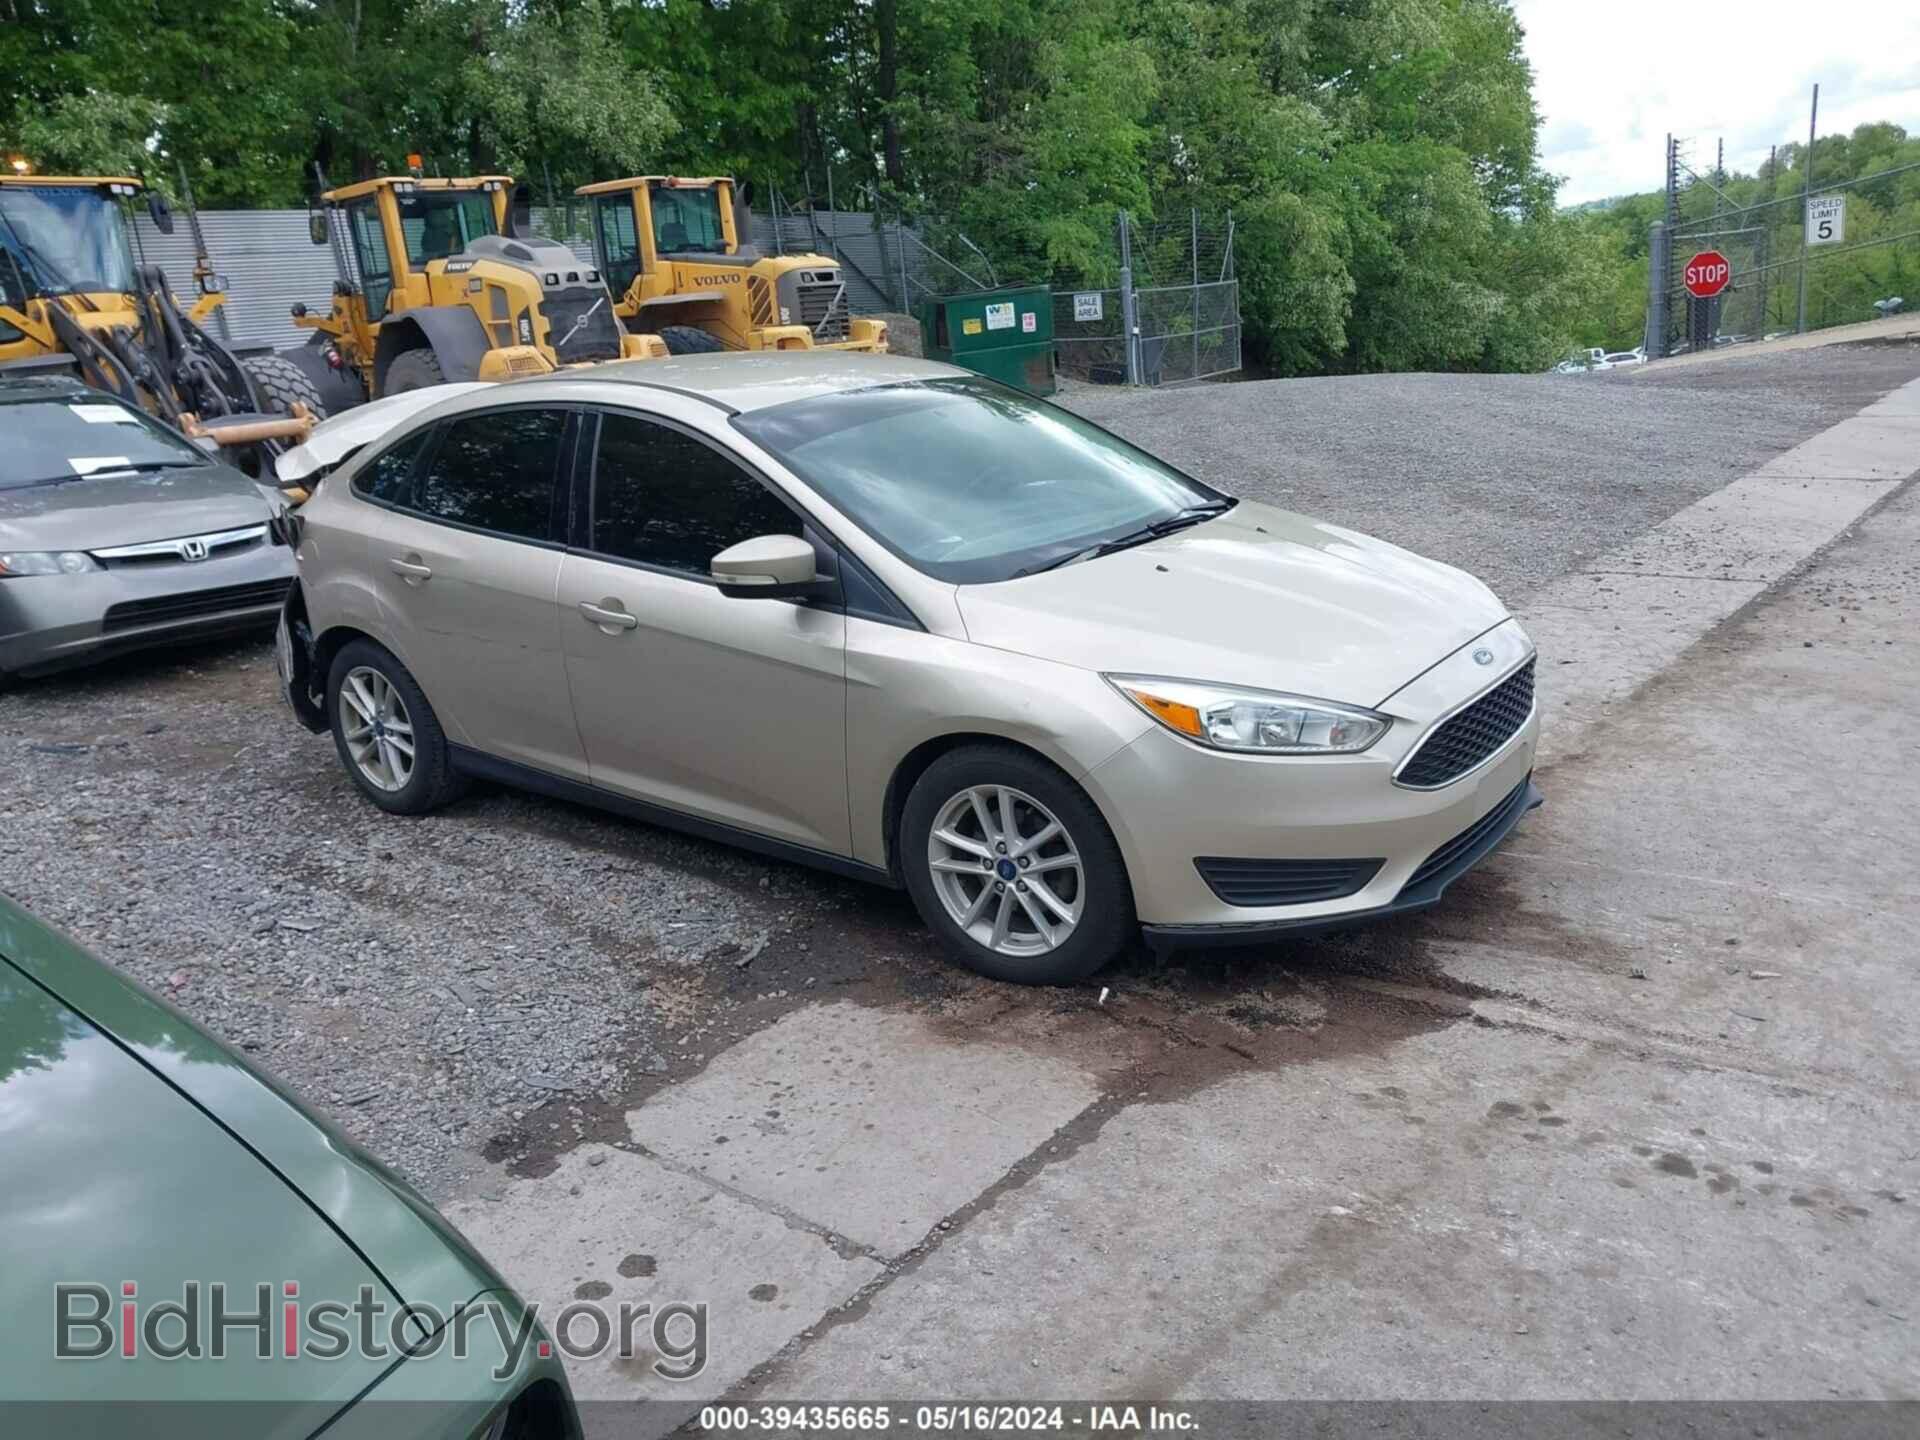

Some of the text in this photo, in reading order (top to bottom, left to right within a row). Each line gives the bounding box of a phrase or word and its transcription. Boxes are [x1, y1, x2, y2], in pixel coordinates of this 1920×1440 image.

[1809, 199, 1841, 209] SPEED
[1811, 207, 1839, 219] LIMIT
[1817, 220, 1833, 239] 5
[693, 273, 741, 286] VOLVO
[1686, 263, 1727, 285] STOP
[1077, 296, 1097, 306] SALE
[1078, 306, 1099, 317] AREA
